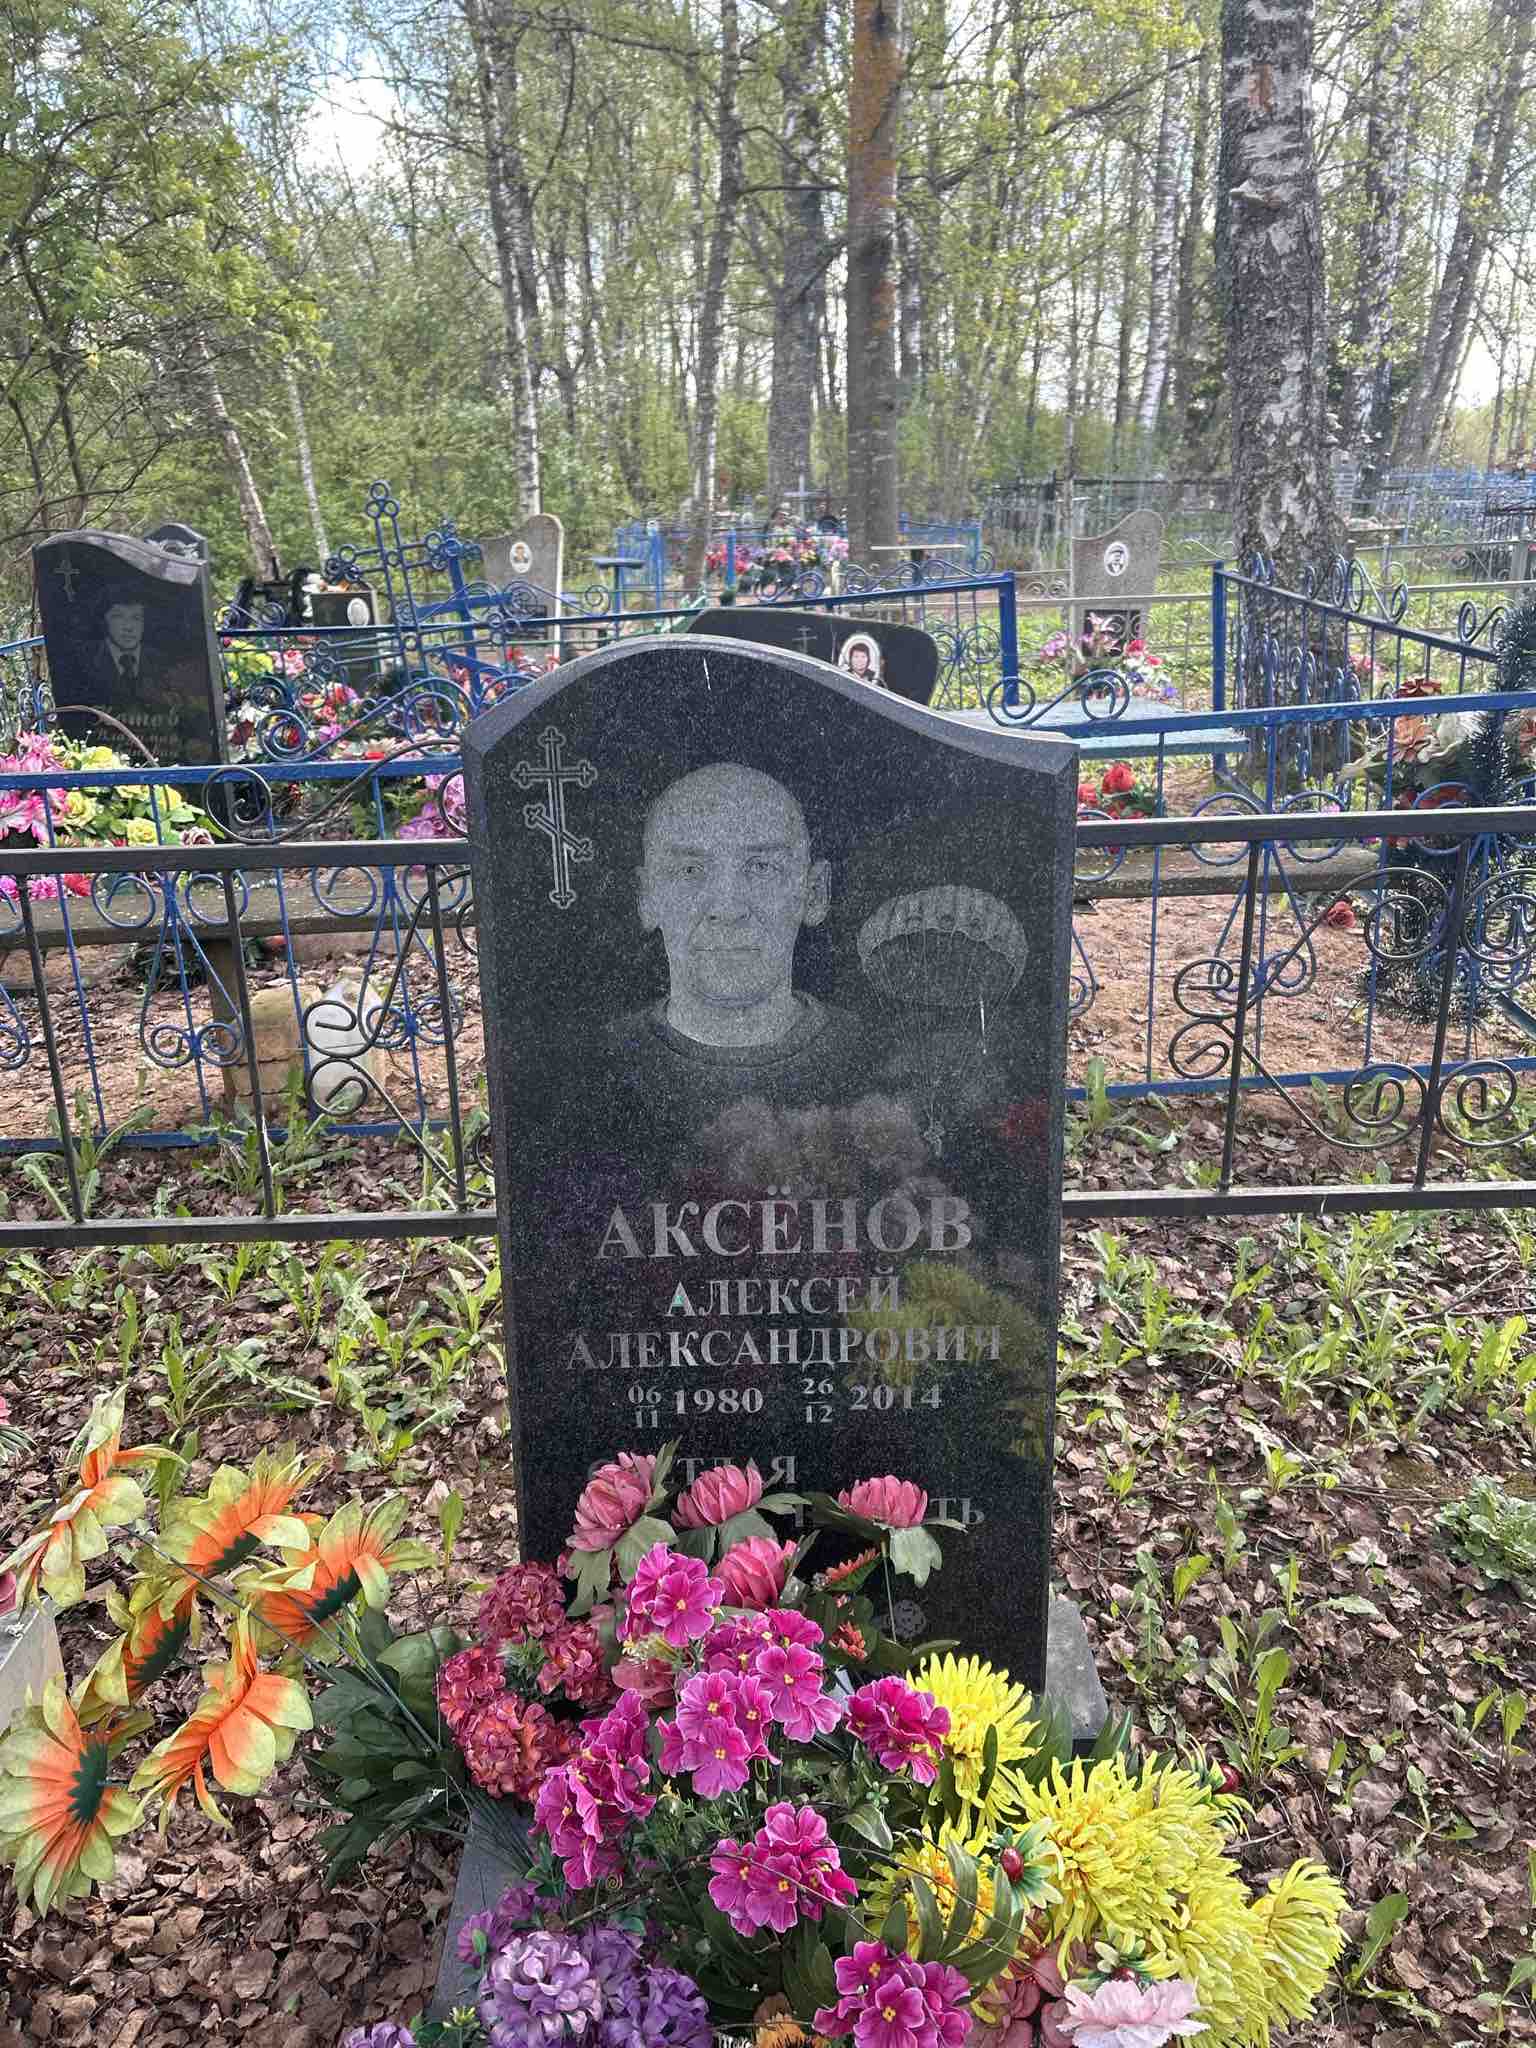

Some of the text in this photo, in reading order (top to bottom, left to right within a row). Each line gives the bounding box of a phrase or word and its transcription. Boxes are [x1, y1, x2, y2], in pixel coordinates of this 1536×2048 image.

[597, 1185, 973, 1259] АКСЁНОВ
[664, 1265, 900, 1317] АЛЕКСЕЙ
[565, 1325, 1001, 1371] АЛЕКСАНДРОВИЧ
[627, 1377, 943, 1415] 06 1980 26 2014
[634, 1404, 834, 1429] 11 12
